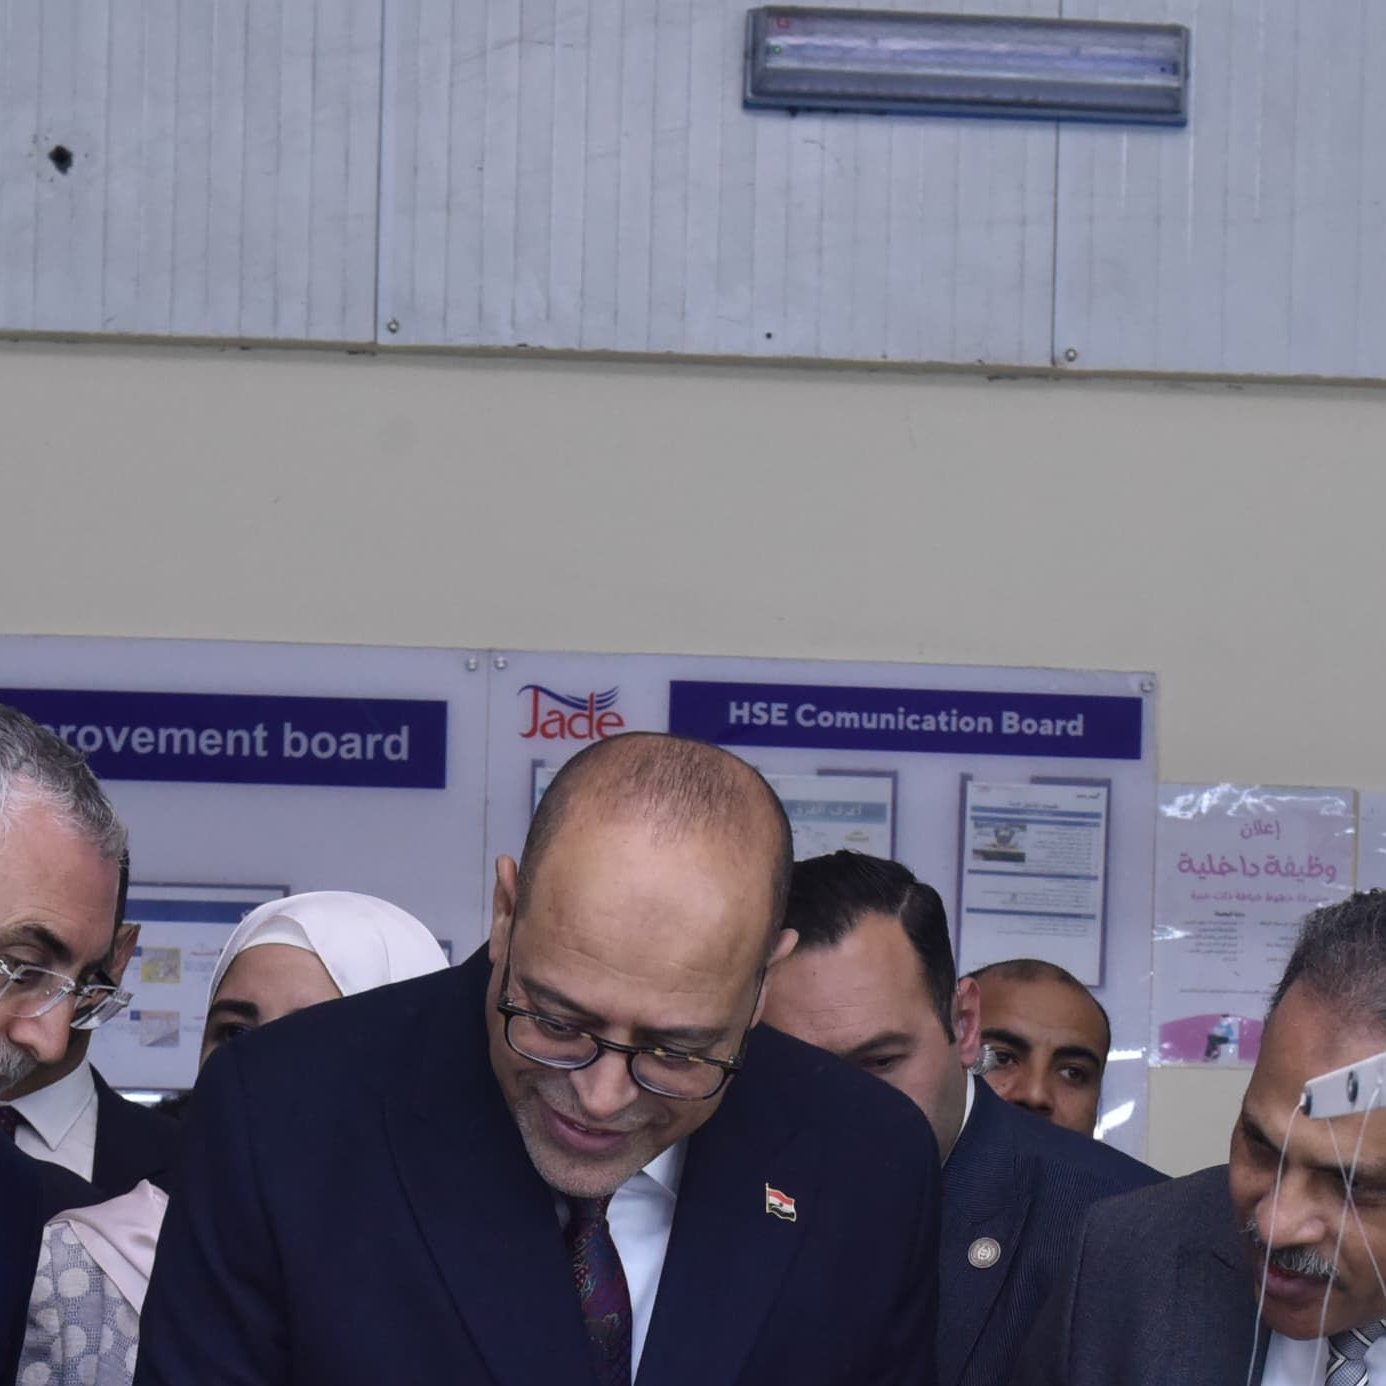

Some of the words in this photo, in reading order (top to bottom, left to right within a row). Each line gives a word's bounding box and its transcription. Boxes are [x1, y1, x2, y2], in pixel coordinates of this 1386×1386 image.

[518, 687, 626, 740] Jade
[727, 701, 789, 727] HSE
[795, 703, 993, 734] Comunication
[1001, 710, 1085, 738] Board
[283, 723, 409, 761] board
[1240, 818, 1282, 840] إعلان
[1177, 852, 1260, 881] داخلية
[1264, 855, 1338, 884] وظيفة
